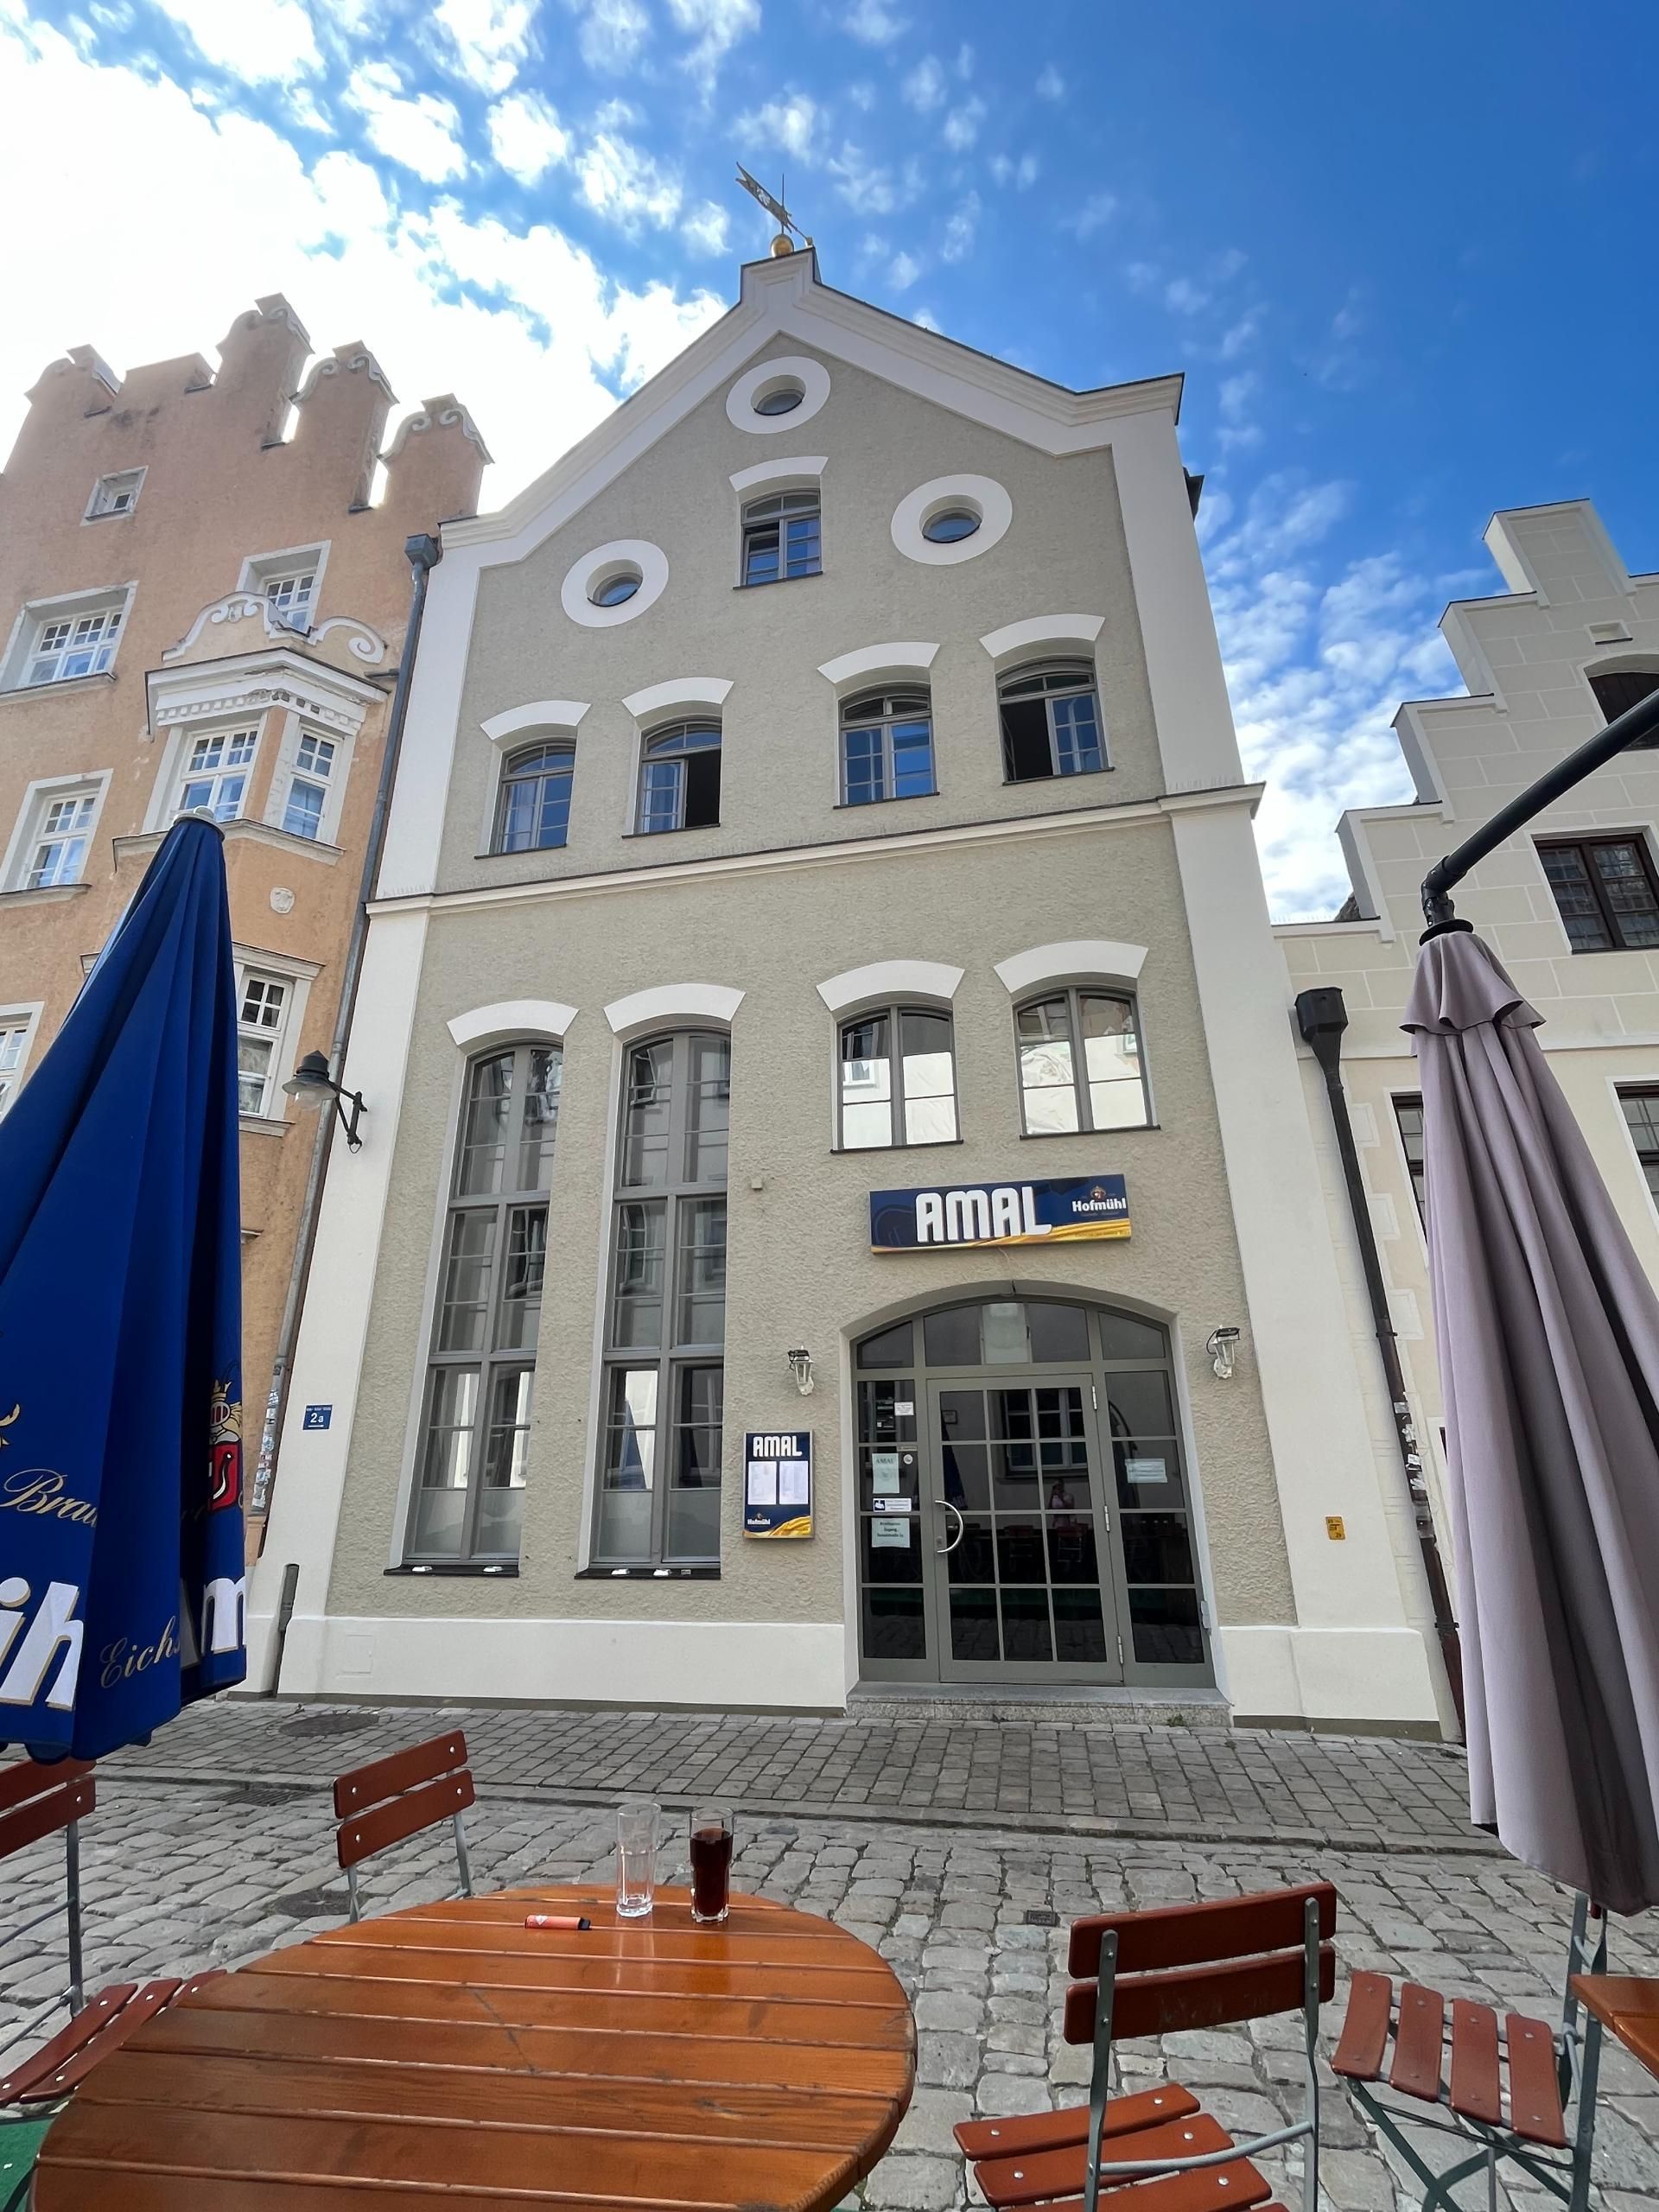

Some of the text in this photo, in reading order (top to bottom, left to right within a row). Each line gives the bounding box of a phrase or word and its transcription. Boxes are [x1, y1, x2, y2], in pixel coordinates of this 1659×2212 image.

[916, 1186, 1052, 1243] AMAL
[1071, 1198, 1127, 1212] Hofmühl
[310, 1412, 324, 1423] 2a
[753, 1435, 803, 1458] AMAL
[99, 1616, 180, 1688] Eich
